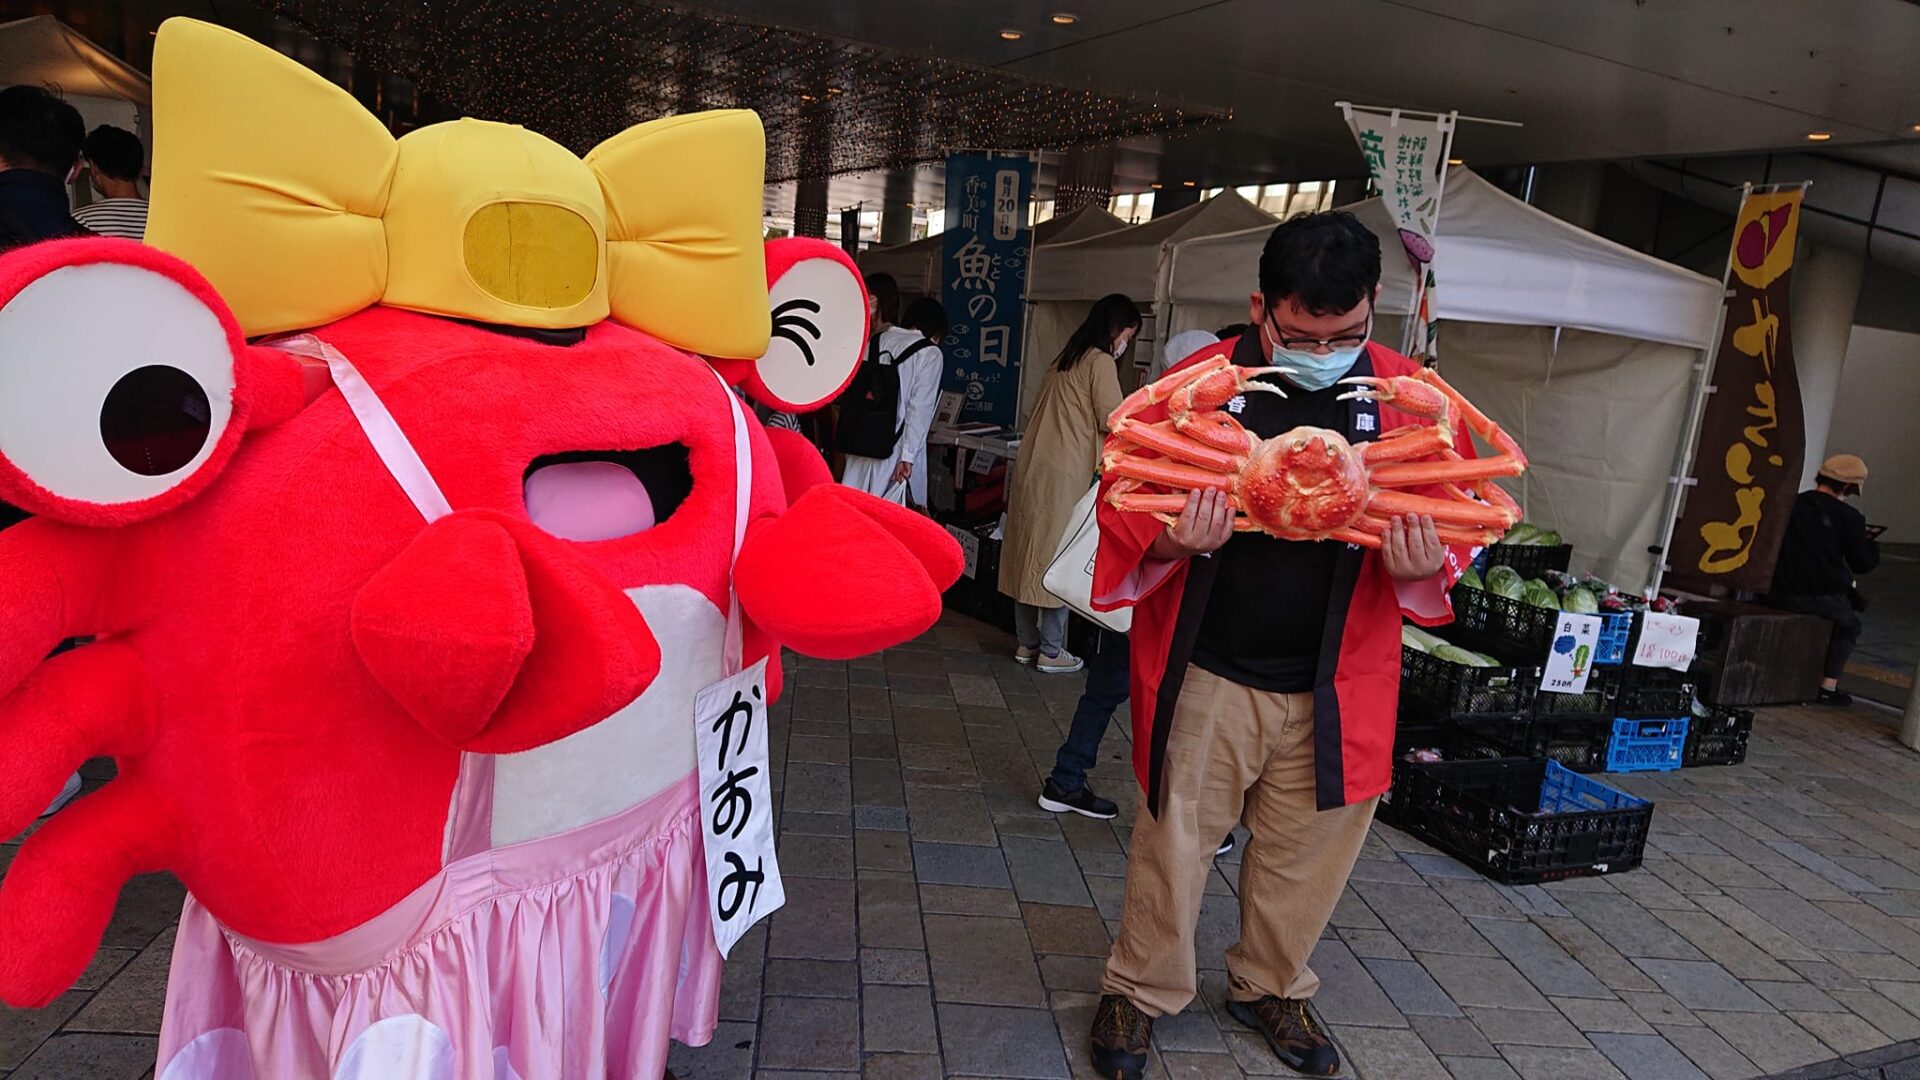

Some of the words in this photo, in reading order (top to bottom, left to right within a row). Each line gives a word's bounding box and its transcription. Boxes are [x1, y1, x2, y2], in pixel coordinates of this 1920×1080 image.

[997, 176, 1015, 236] 毎月20日は
[951, 235, 1011, 368] 魚の日
[1551, 679, 1573, 688] 250円
